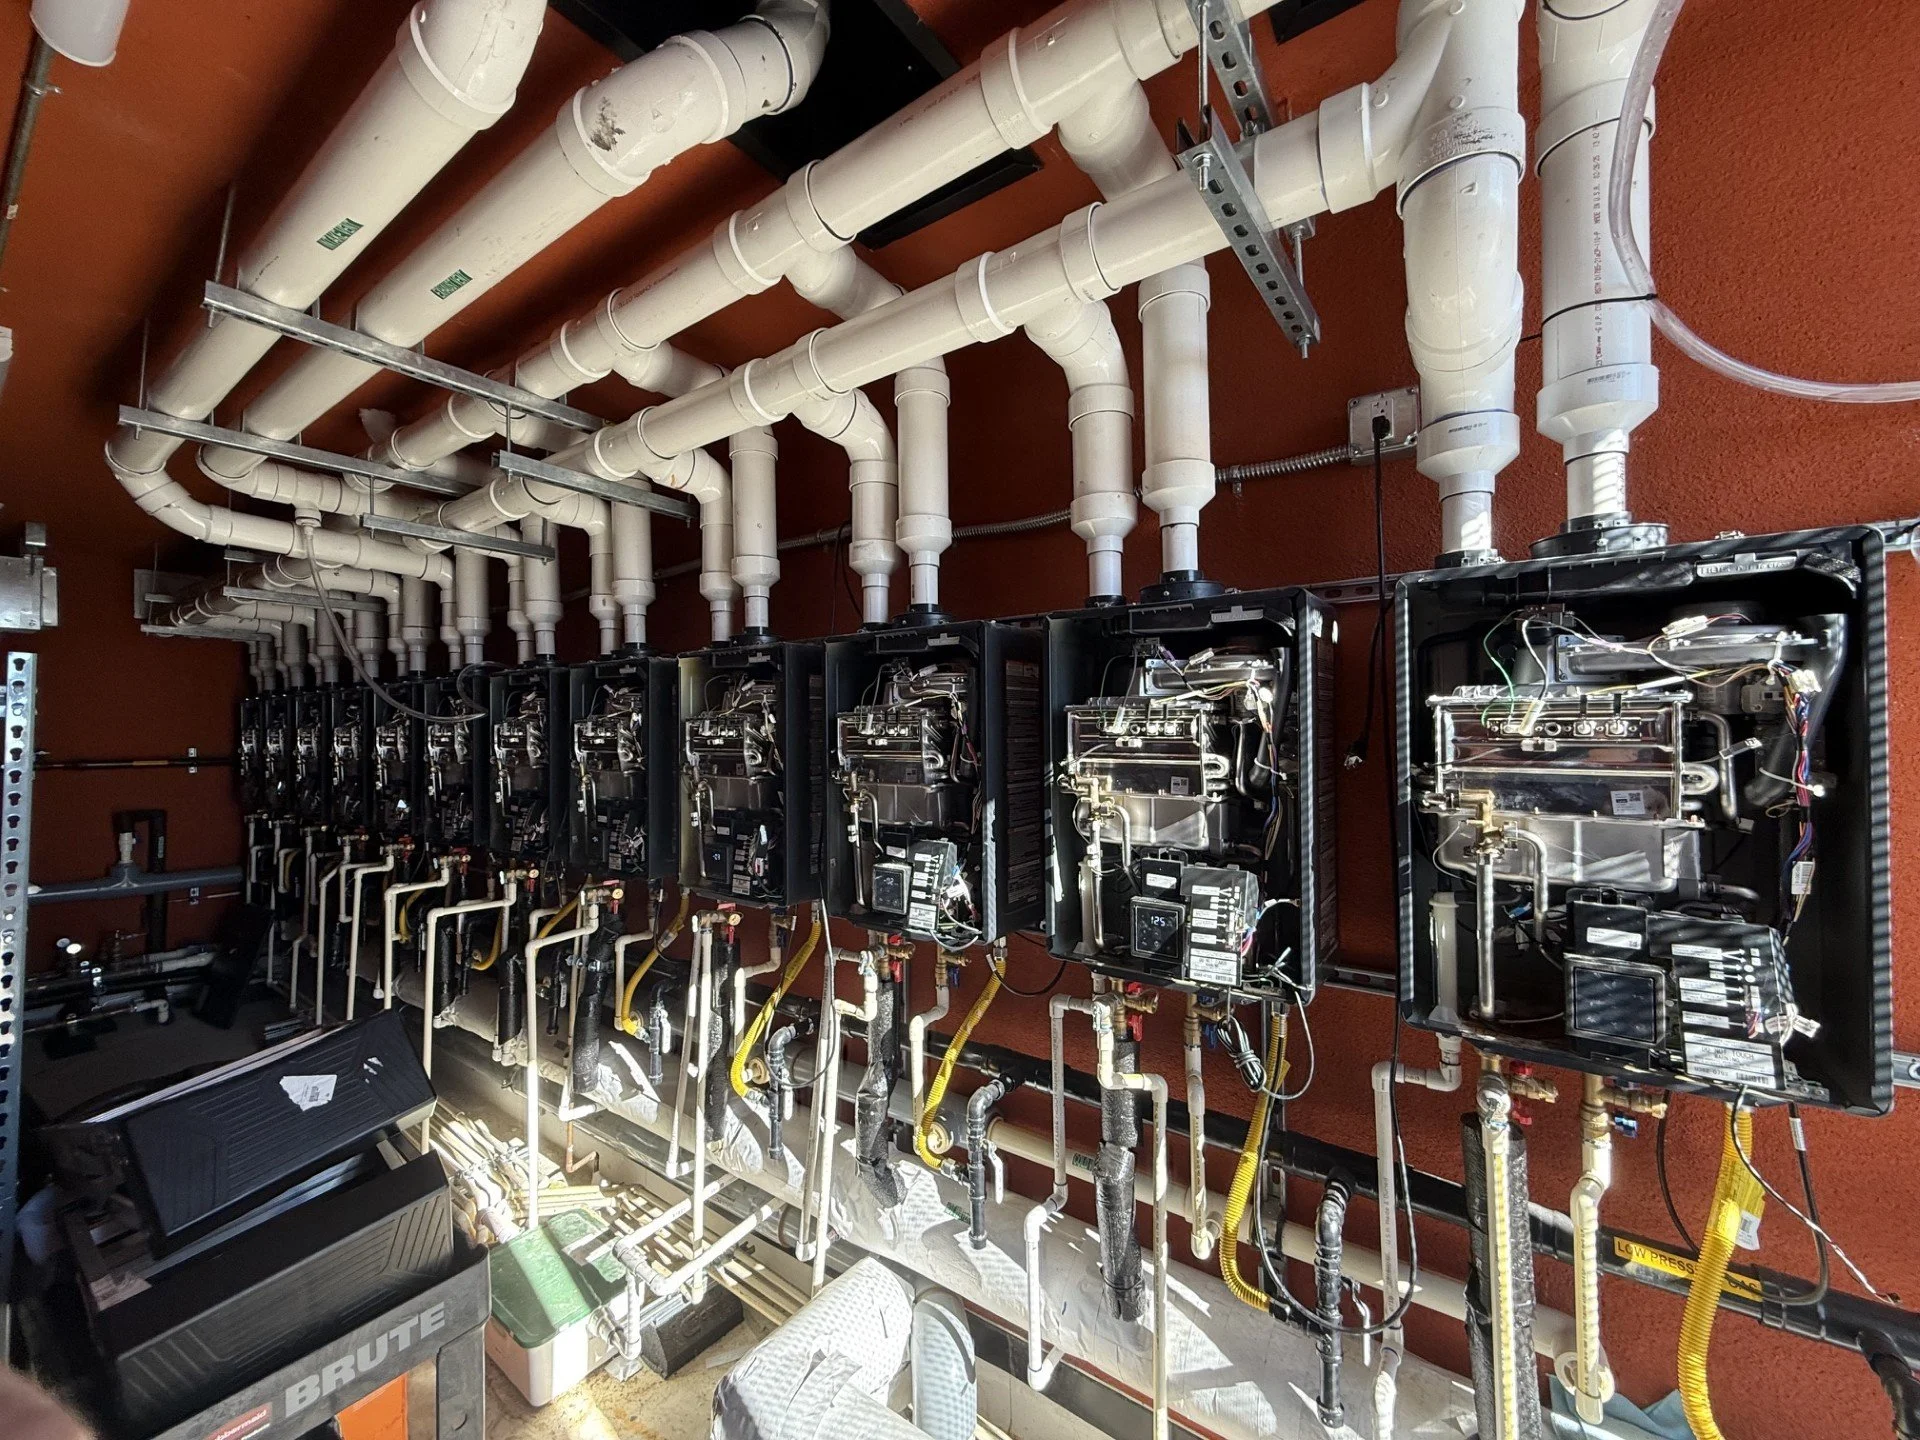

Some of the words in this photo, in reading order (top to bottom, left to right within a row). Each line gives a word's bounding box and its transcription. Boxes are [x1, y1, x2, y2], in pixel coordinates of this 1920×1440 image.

[1150, 915, 1166, 927] 125
[1617, 1241, 1645, 1259] LOW
[1650, 1252, 1698, 1275] PRESS
[285, 1301, 445, 1419] BRUTE
